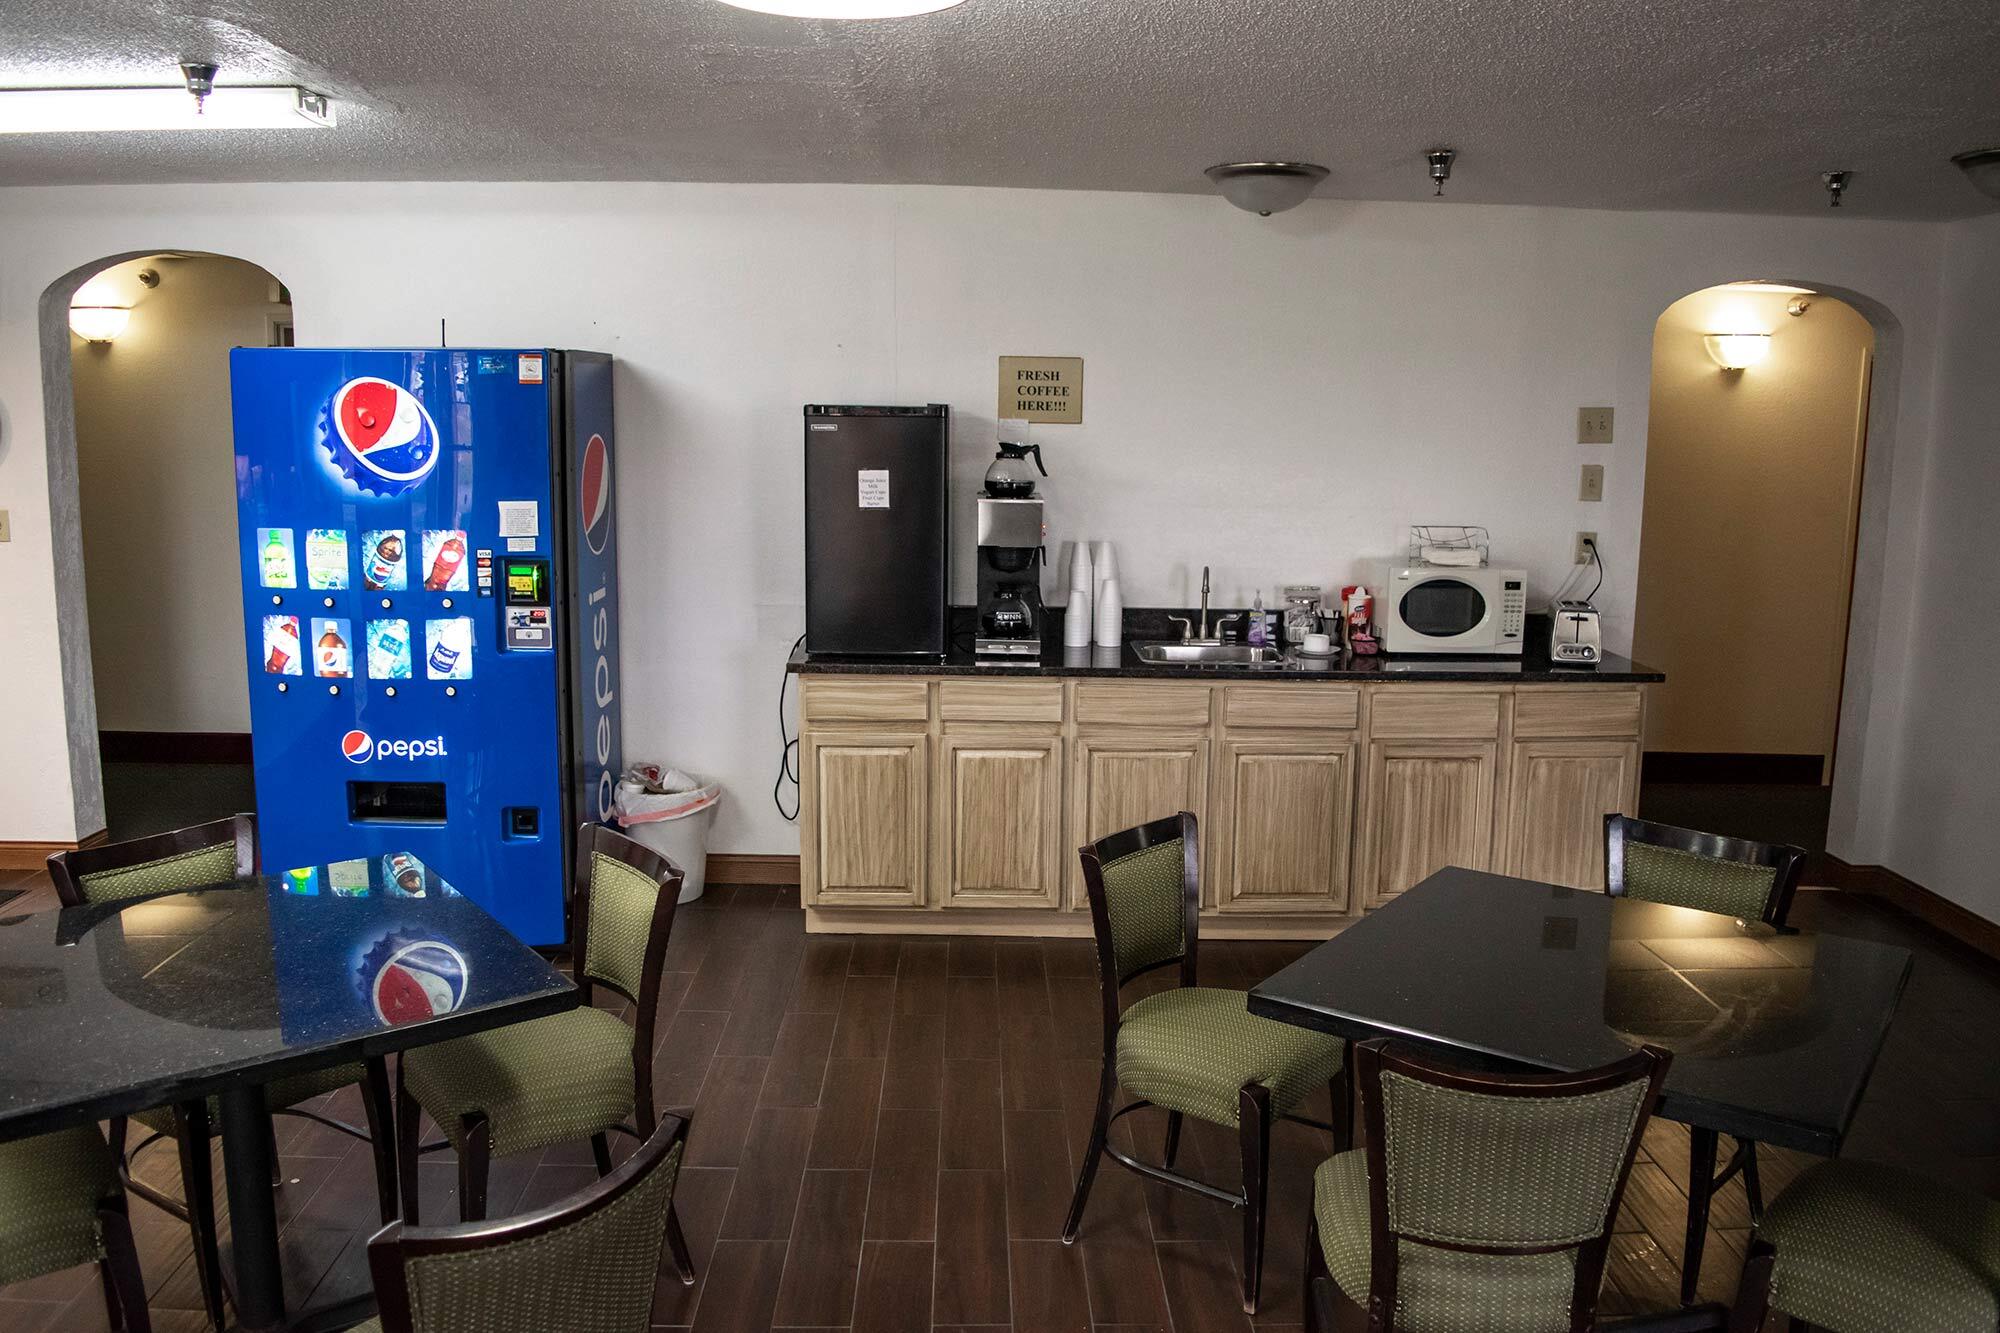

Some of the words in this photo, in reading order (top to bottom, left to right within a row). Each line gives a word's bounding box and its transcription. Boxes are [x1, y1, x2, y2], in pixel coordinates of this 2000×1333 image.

[1017, 370, 1060, 381] FRESH
[1017, 385, 1070, 397] COFFEE
[1017, 400, 1066, 412] HERE!!!
[311, 546, 342, 559] Sprite
